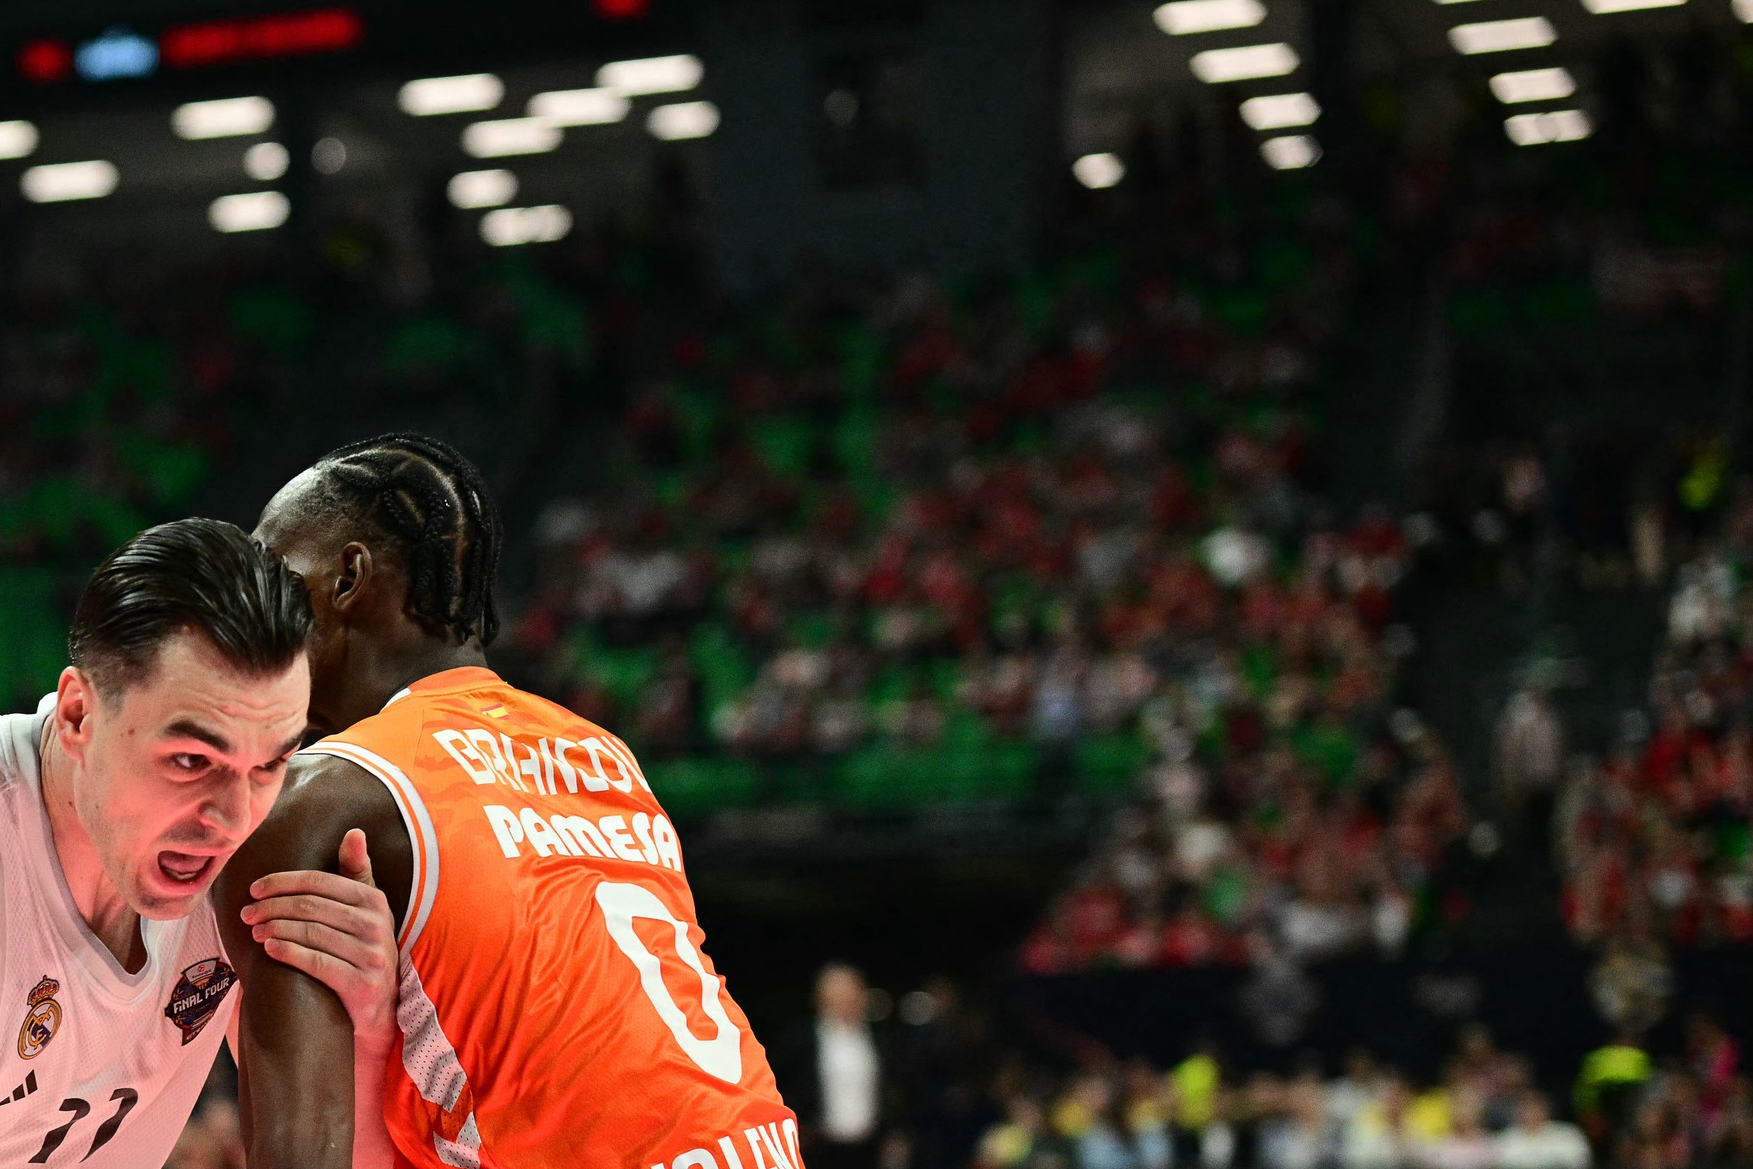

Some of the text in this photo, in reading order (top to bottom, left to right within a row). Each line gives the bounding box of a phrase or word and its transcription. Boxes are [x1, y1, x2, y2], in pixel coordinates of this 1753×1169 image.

[483, 805, 681, 872] PAMESA
[173, 977, 229, 1014] FINAL FOUR
[595, 881, 742, 1084] 0
